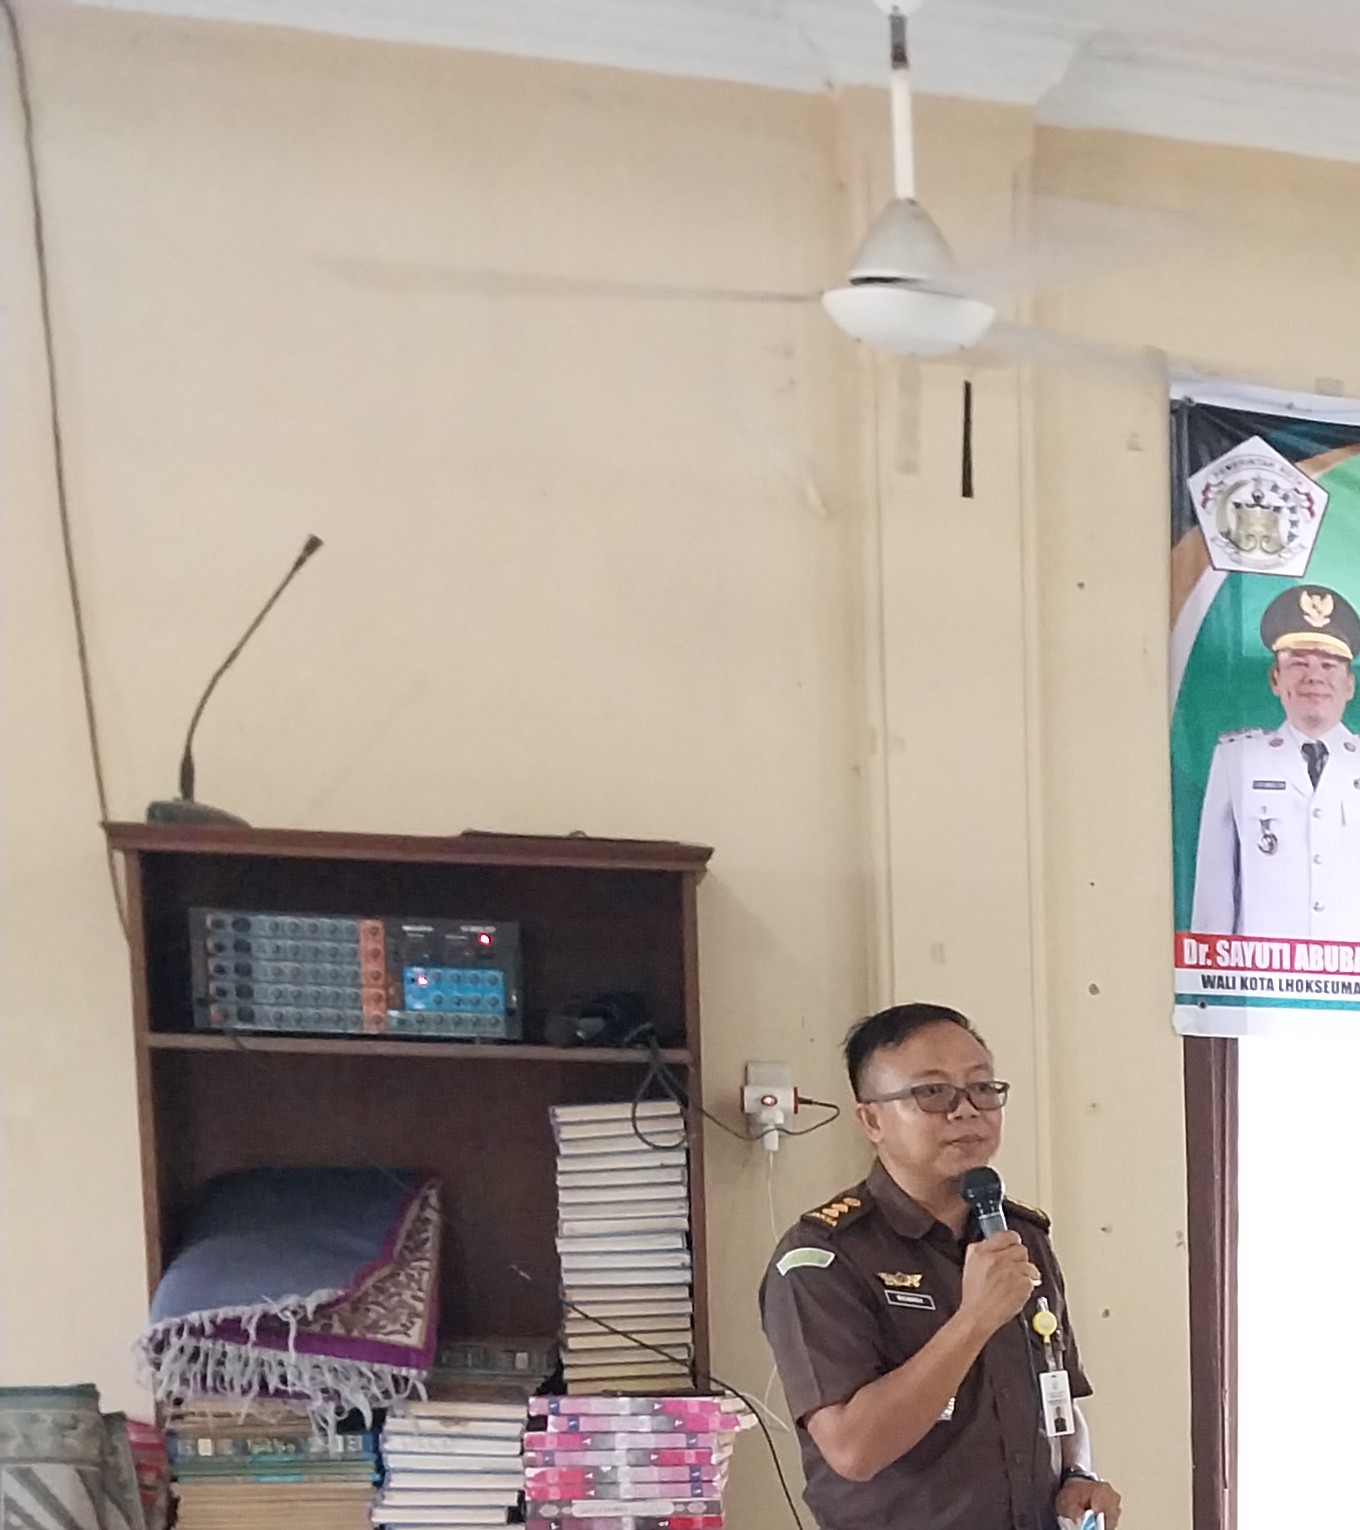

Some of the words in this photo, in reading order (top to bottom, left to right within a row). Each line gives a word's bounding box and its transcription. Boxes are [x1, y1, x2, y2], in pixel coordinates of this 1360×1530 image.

[1183, 938, 1213, 967] Dr.
[1216, 940, 1291, 970] SAYUTI
[1200, 974, 1236, 990] WALI
[1239, 976, 1275, 992] KOTA
